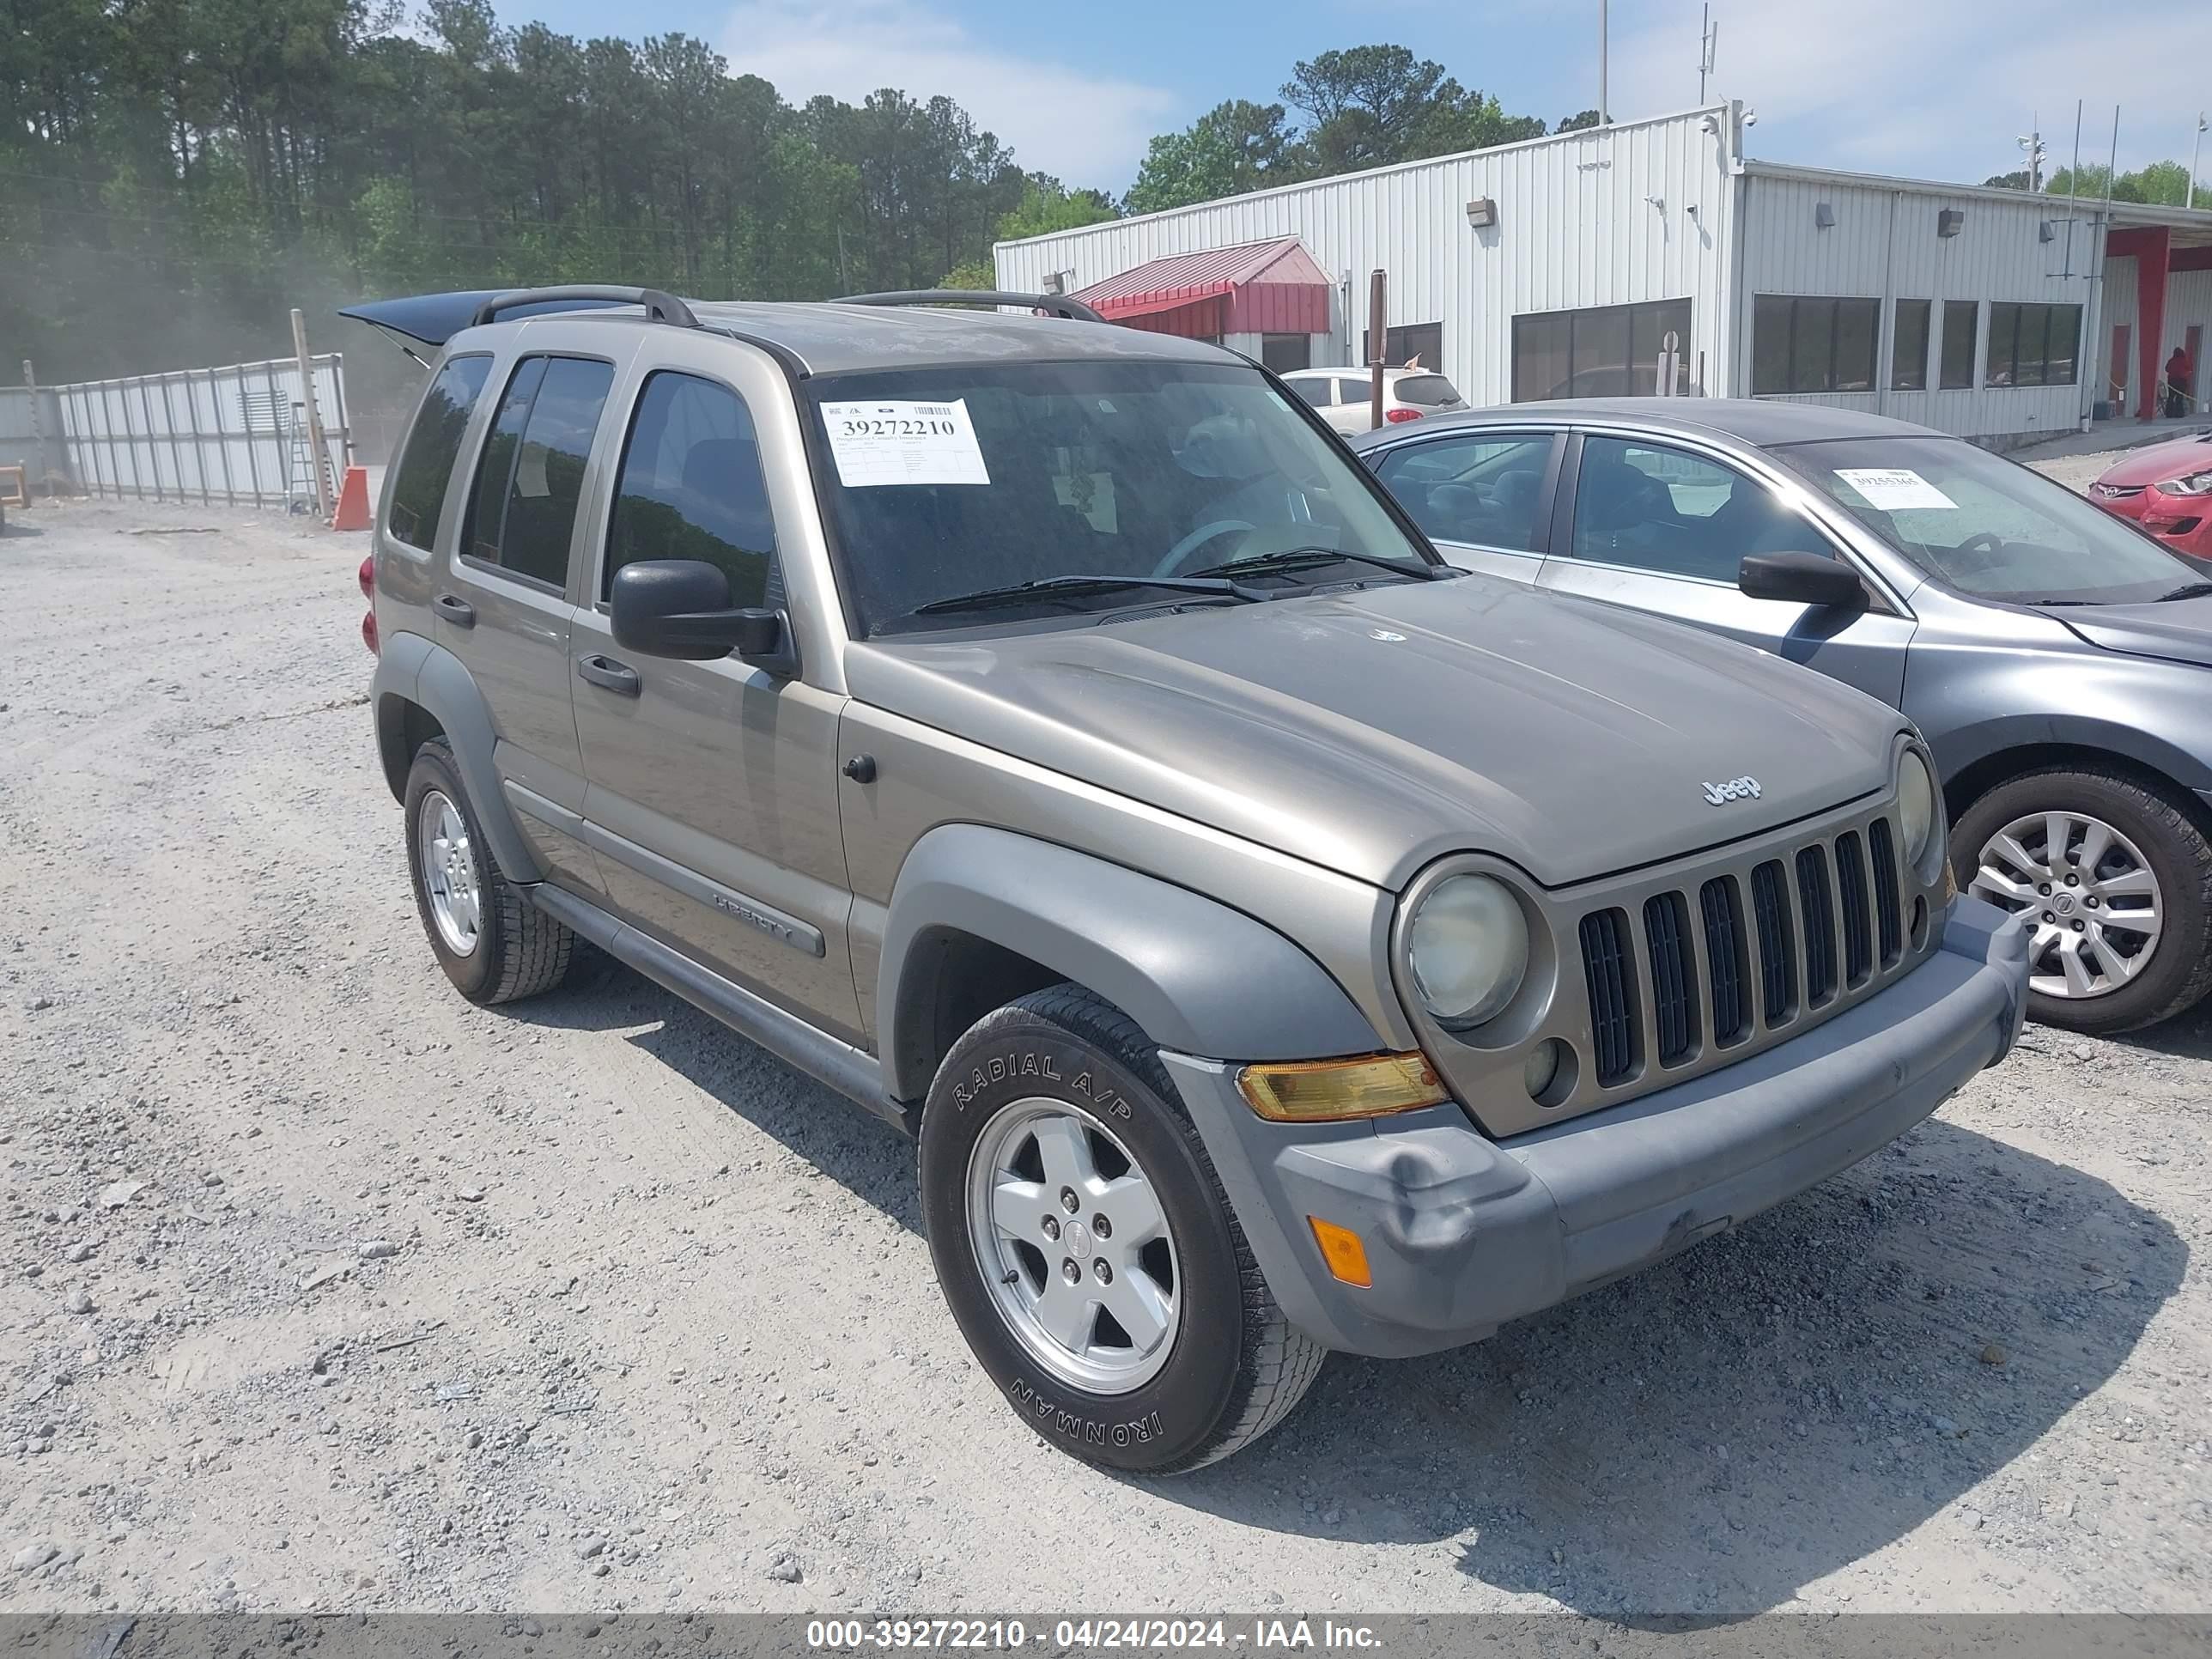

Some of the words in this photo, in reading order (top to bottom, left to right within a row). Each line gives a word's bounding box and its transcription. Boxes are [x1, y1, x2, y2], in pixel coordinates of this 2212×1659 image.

[842, 420, 955, 435] 39272210
[1700, 775, 1761, 805] Jeep
[713, 893, 793, 939] LIBERTY
[951, 1053, 1061, 1112] RADIAL
[1072, 1071, 1132, 1120] A/P
[1010, 1377, 1164, 1447] IRONMAN
